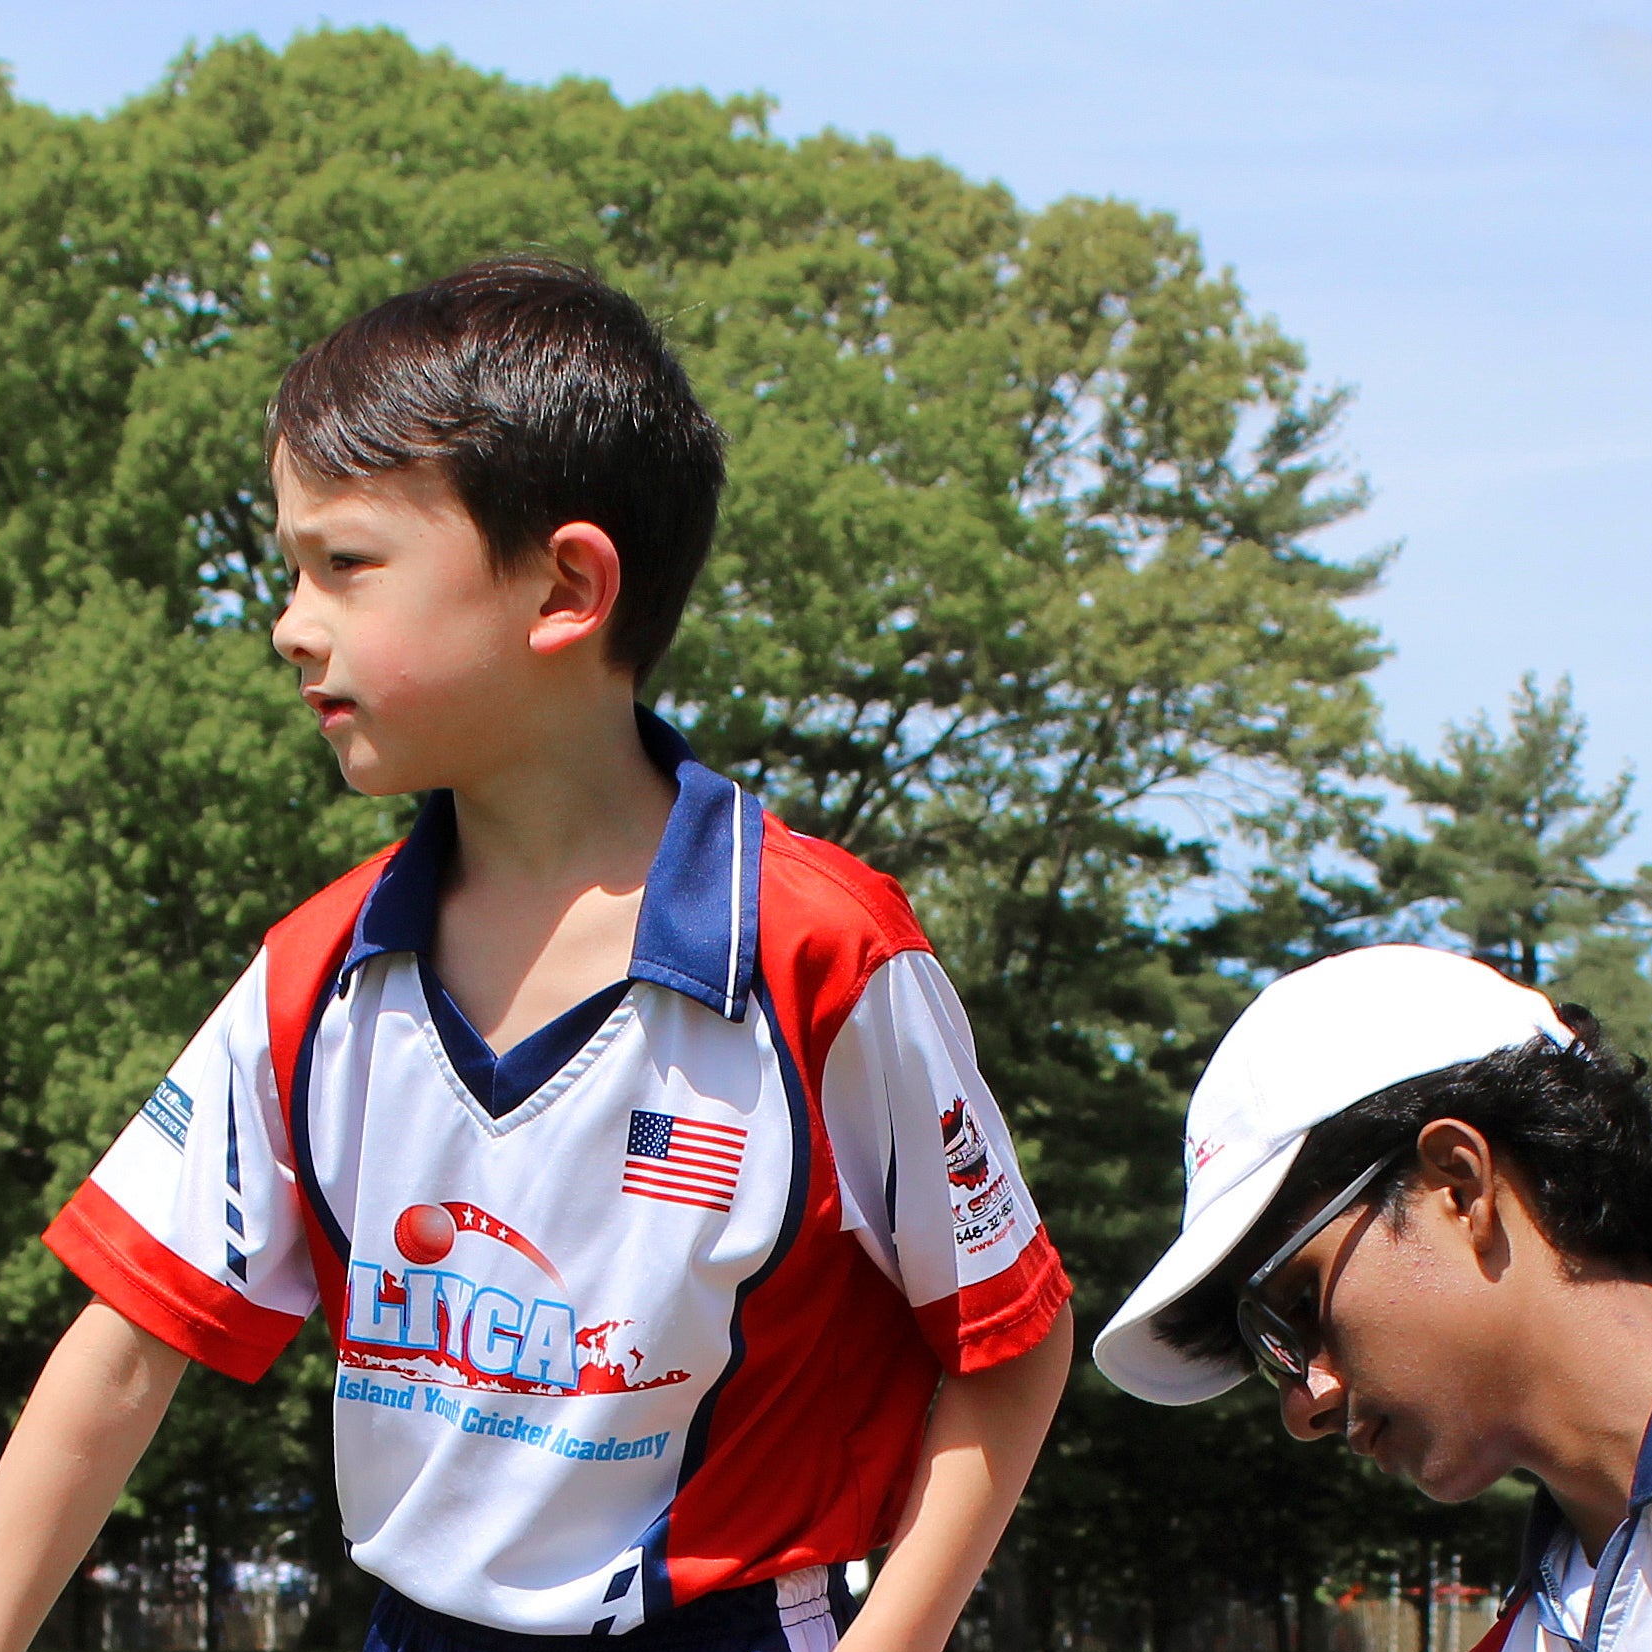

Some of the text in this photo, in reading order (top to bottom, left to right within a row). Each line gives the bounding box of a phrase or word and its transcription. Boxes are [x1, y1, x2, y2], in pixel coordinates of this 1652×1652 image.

[347, 1261, 578, 1389] LIYCA
[337, 1374, 415, 1410] Island
[461, 1407, 552, 1447] Cricket
[549, 1428, 670, 1461] Academy
